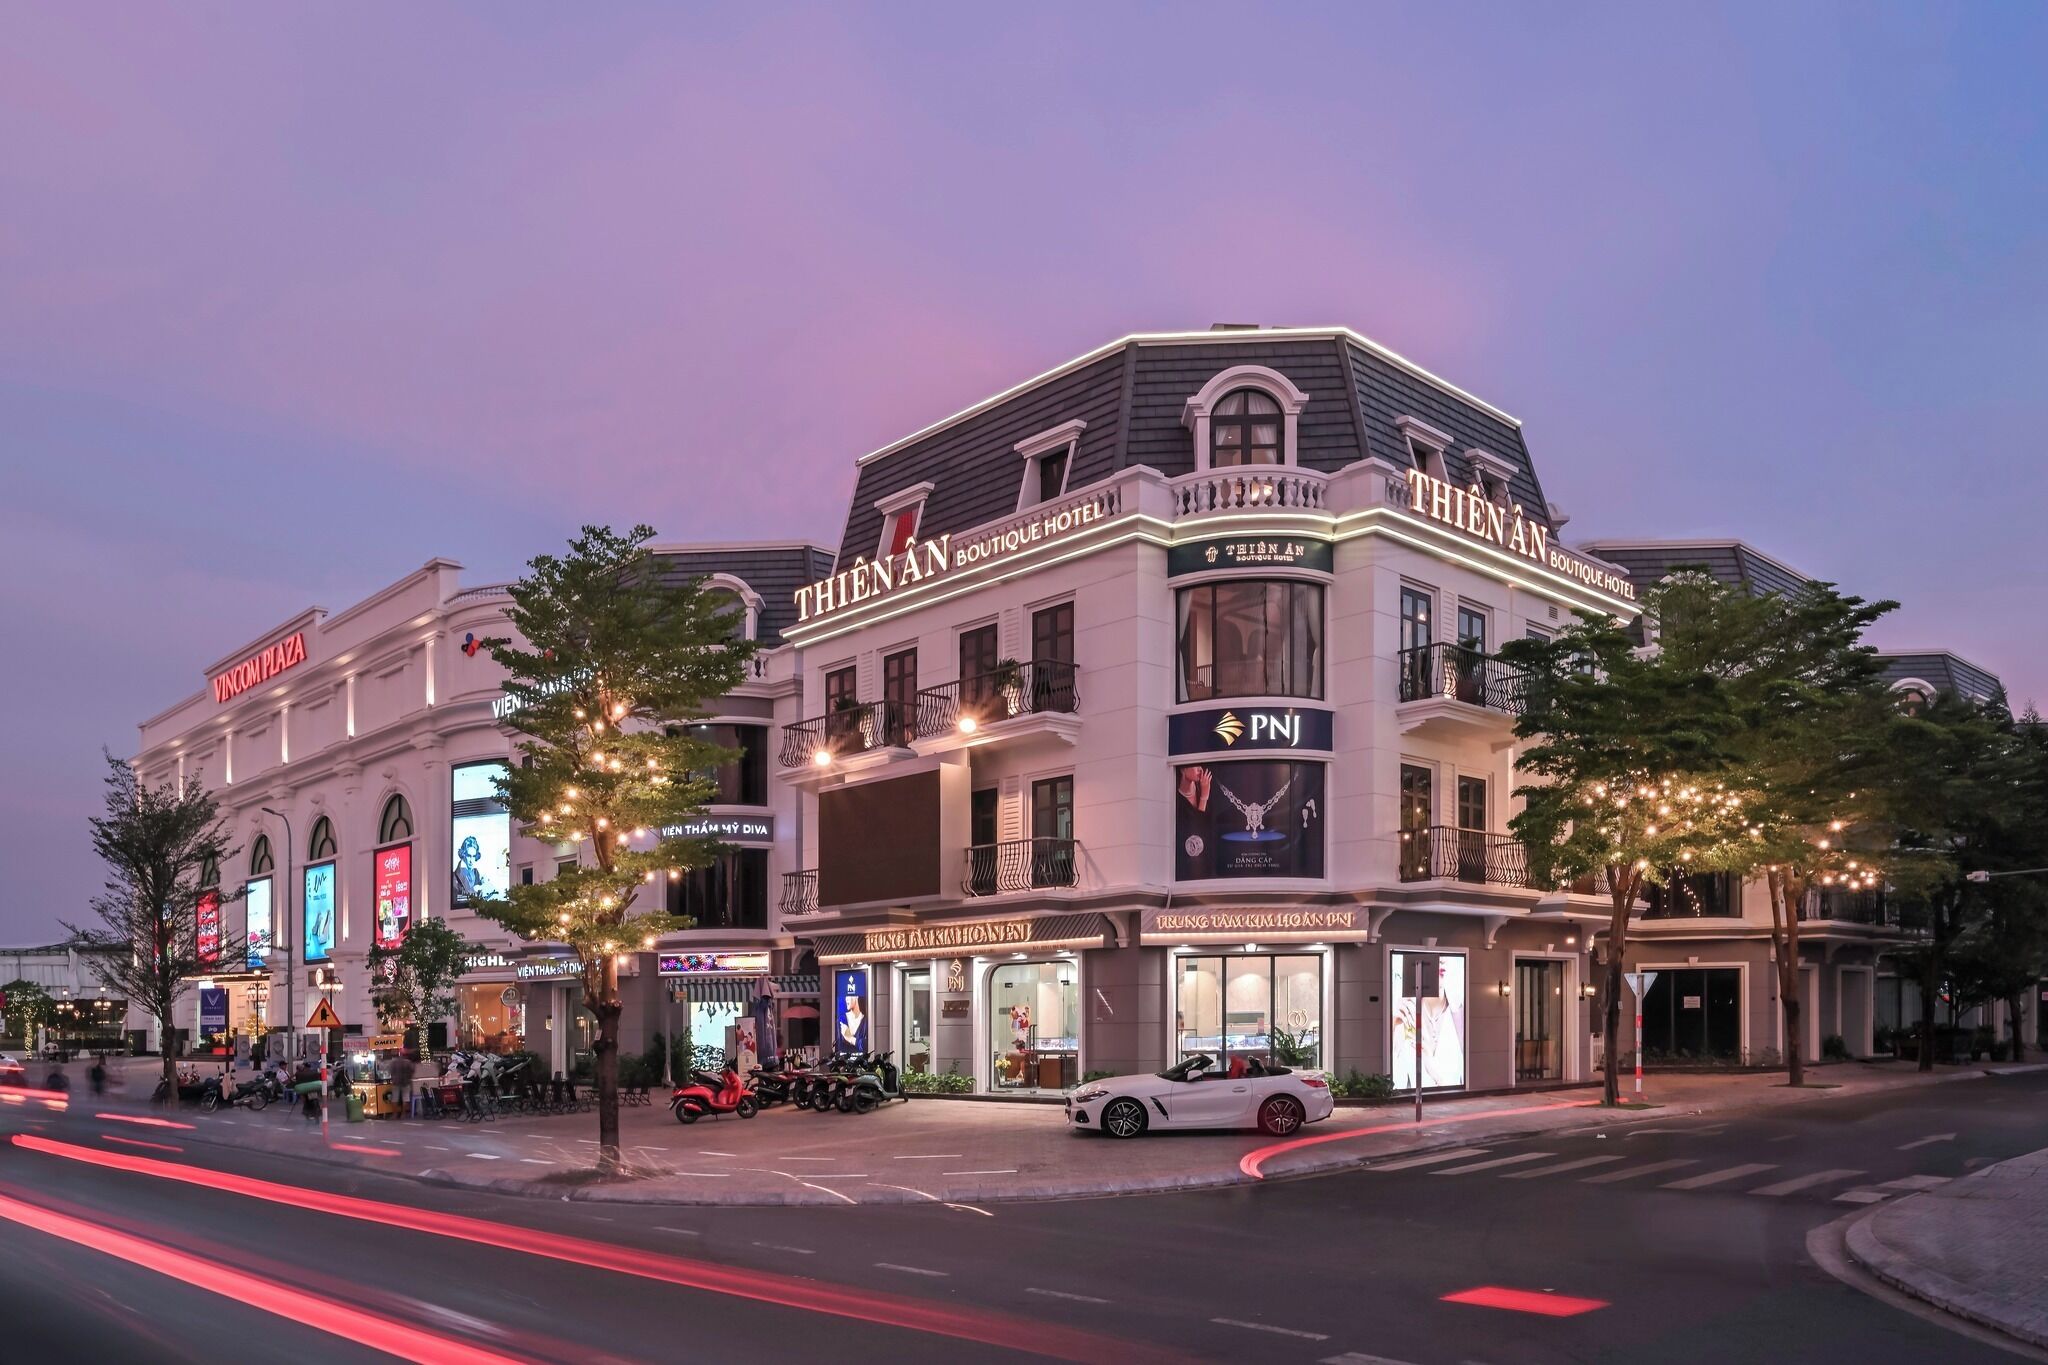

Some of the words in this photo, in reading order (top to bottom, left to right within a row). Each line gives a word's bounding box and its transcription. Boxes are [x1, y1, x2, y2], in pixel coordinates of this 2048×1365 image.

[1406, 468, 1505, 545] THIÊN
[1508, 503, 1548, 562] ÂN
[1550, 550, 1604, 585] BOUTIQUE
[1604, 573, 1636, 600] HOTEL
[1225, 540, 1279, 555] THIÊN
[794, 554, 894, 622] THIÊN
[899, 535, 951, 586] ÂN
[956, 522, 1041, 566] BOUTIQUE
[1044, 501, 1104, 536] HOTEL
[1235, 554, 1272, 562] BOUTIQUE
[1273, 554, 1294, 562] HOTEL
[213, 655, 263, 703] VINCOM
[263, 631, 307, 681] PLAZA
[1250, 714, 1301, 747] PNJ
[742, 824, 768, 835] DIVA
[1156, 914, 1209, 929] TRUNG
[1211, 914, 1244, 928] TÂM
[1245, 913, 1276, 928] KIM
[1326, 912, 1354, 928] PNJ
[947, 975, 965, 992] PNJ
